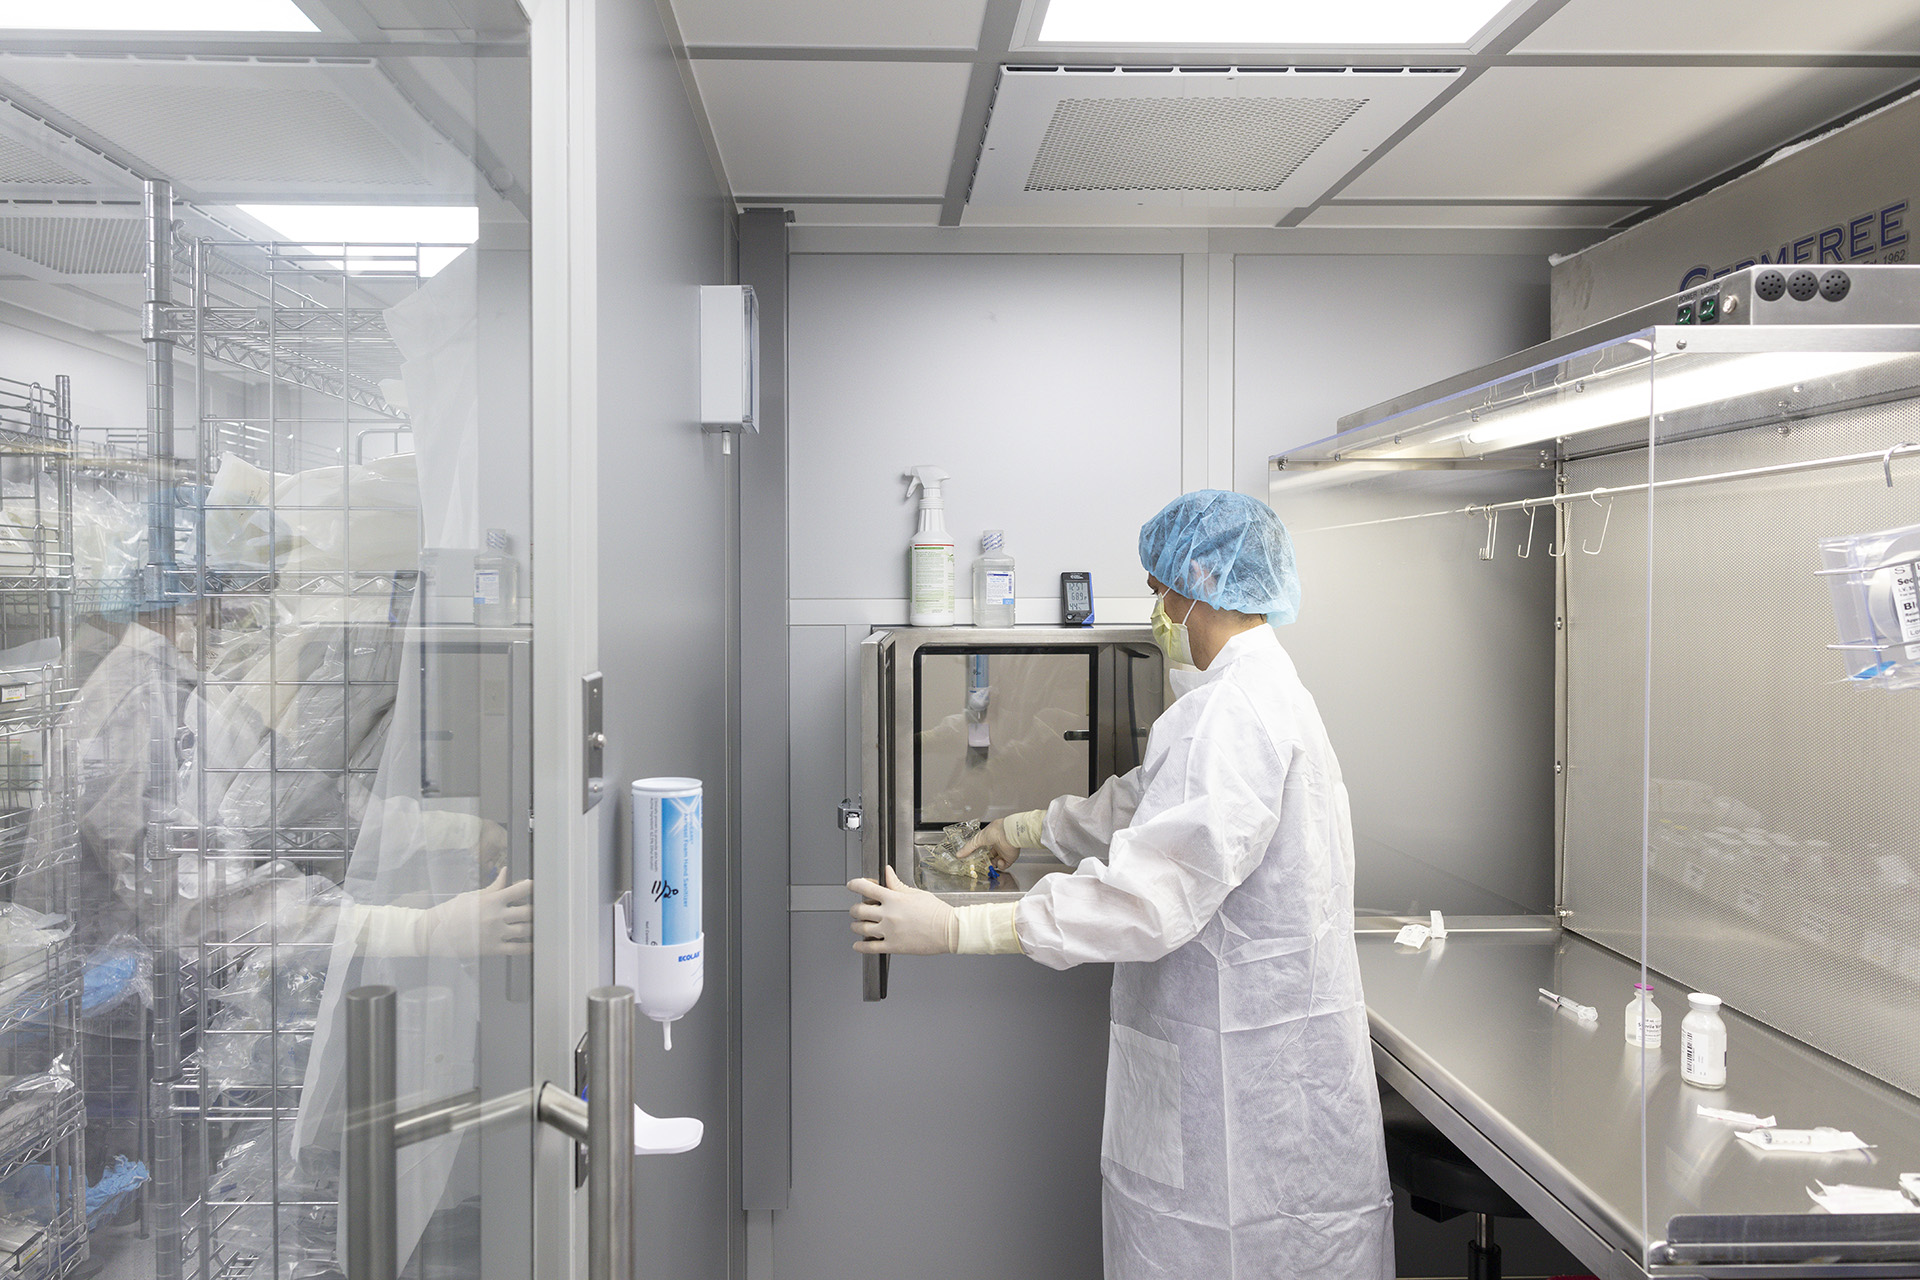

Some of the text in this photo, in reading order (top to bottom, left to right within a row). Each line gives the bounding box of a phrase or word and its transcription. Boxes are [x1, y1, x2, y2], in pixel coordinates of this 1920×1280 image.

[1679, 199, 1909, 292] MFREE
[1884, 249, 1906, 264] 1962
[1700, 282, 1720, 295] LIGHTS
[1679, 291, 1698, 304] POWER
[1897, 577, 1914, 586] Sec
[1903, 601, 1916, 610] Bl
[651, 880, 679, 902] 11/20
